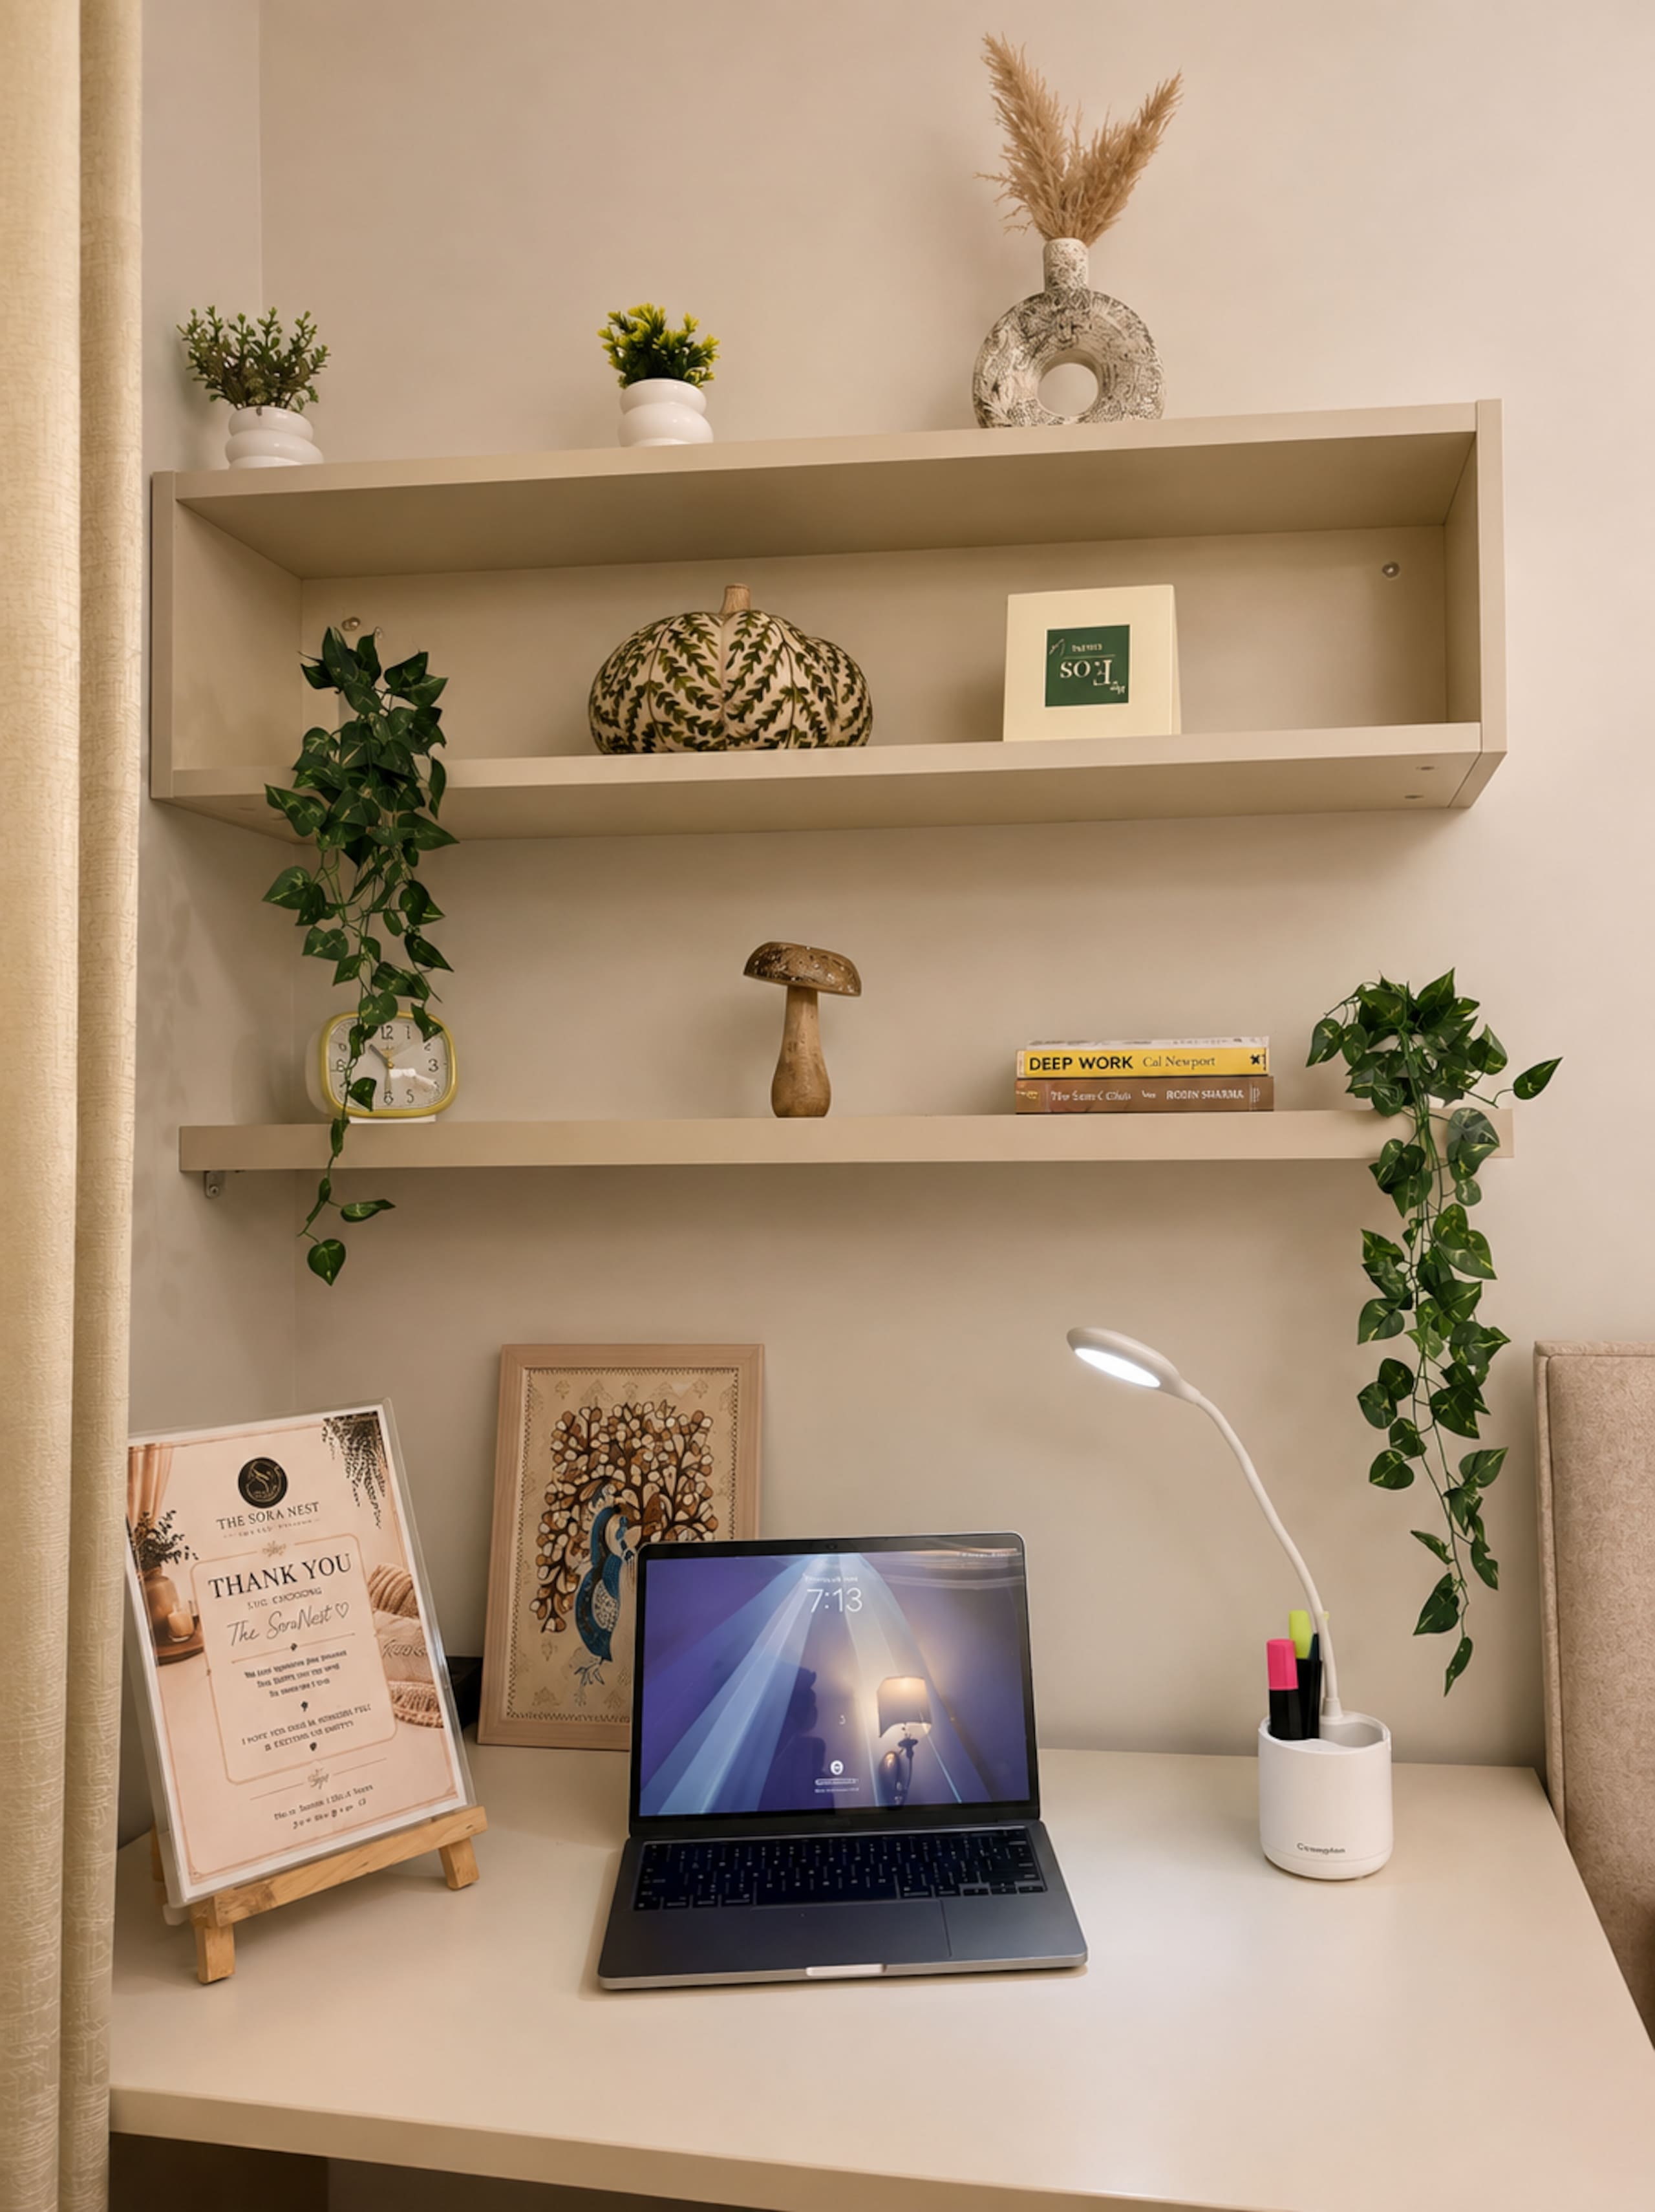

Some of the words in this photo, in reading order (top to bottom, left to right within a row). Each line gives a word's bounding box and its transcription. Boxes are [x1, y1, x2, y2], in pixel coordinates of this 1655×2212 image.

[380, 1025, 394, 1040] 12
[428, 1058, 439, 1072] 3
[1029, 1057, 1073, 1071] DEEP
[1078, 1055, 1134, 1070] WORK
[1142, 1055, 1162, 1068] Cal
[1165, 1055, 1215, 1070] Newport
[406, 1089, 414, 1103] 5
[216, 1515, 246, 1530] THE
[248, 1510, 284, 1525] SORA
[287, 1501, 319, 1517] NEST
[208, 1563, 297, 1598] THANK
[301, 1553, 352, 1580] YOU
[806, 1587, 862, 1613] 7:13
[227, 1620, 260, 1647] The
